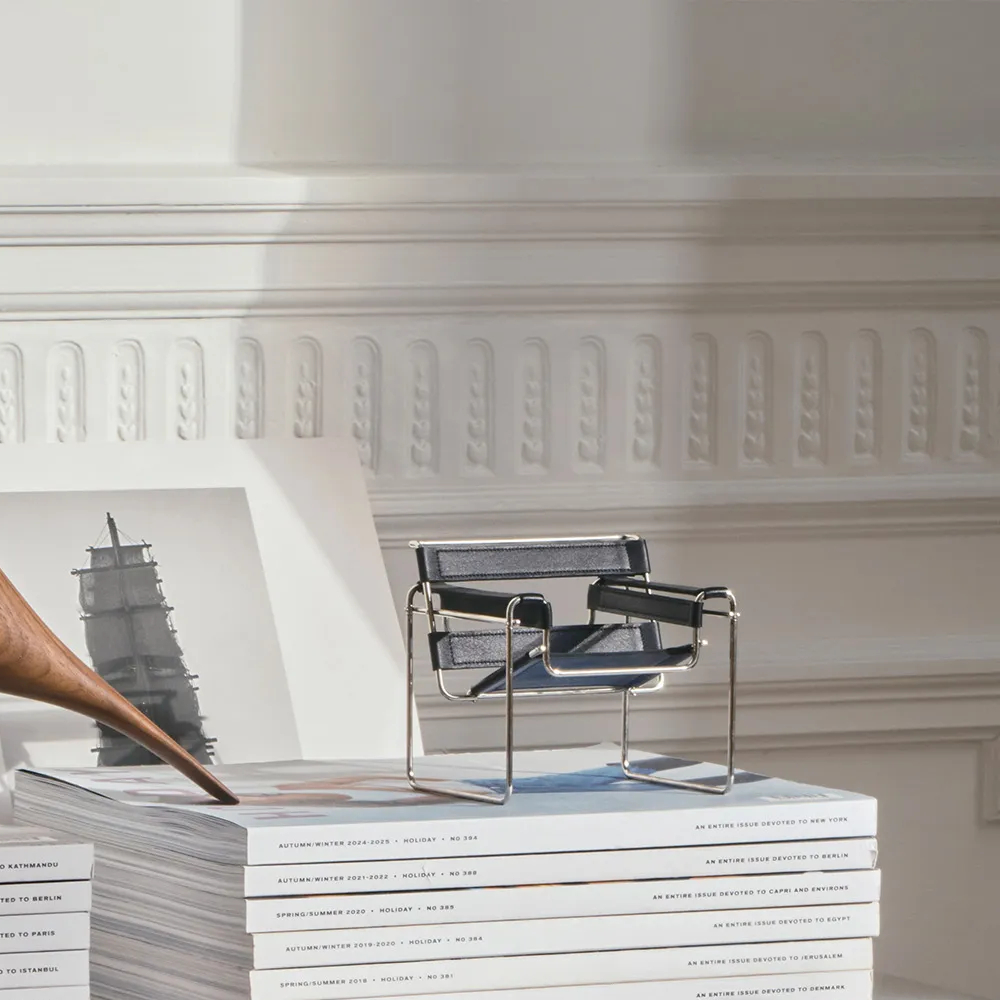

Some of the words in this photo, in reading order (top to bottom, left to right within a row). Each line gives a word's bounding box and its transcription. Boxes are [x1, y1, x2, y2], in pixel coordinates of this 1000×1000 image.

[707, 822, 735, 830] ENTIRE
[760, 819, 796, 827] DEVOTED
[278, 840, 345, 849] AUTUMN/WINTER
[347, 838, 390, 846] 2024-2025
[7, 862, 59, 870] KATHMANDU
